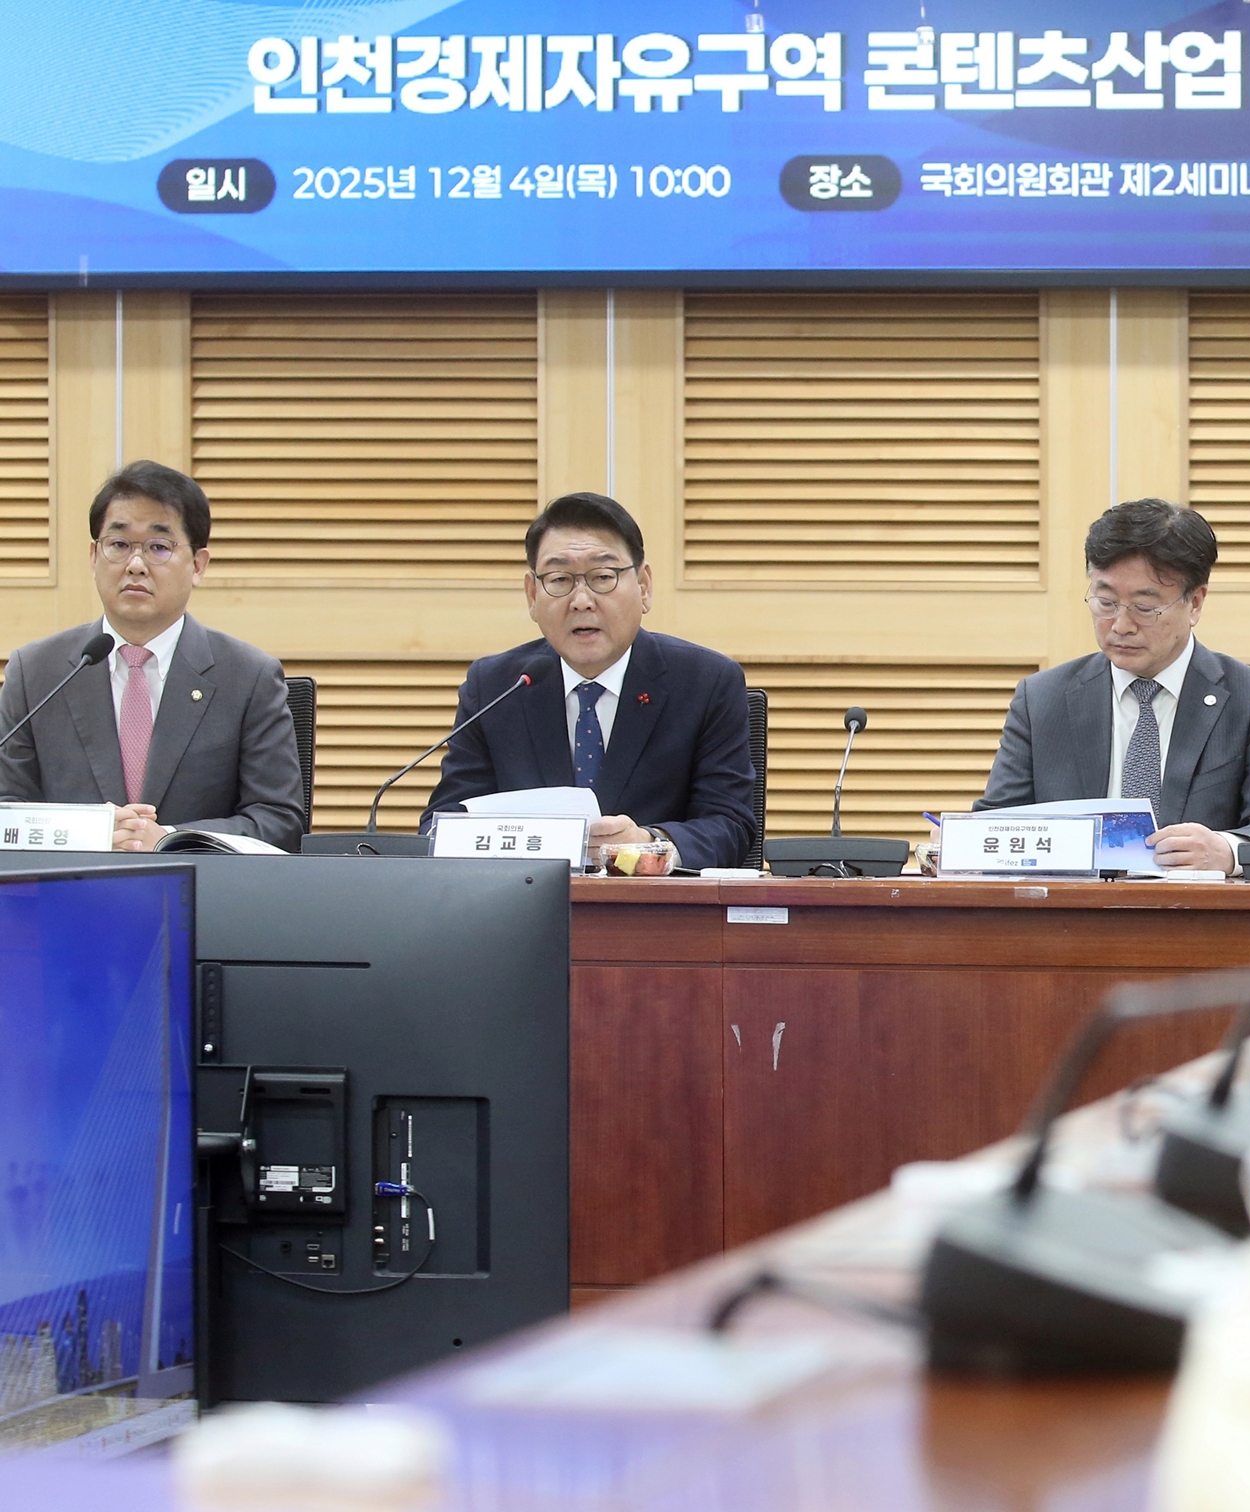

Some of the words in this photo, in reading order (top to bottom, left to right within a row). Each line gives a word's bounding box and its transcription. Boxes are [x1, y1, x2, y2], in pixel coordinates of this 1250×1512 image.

[247, 33, 842, 114] 인천경제자유구역
[864, 30, 1242, 110] 콘텐츠산업
[185, 167, 246, 201] 일시
[292, 165, 416, 199] 2025년
[428, 165, 502, 199] 12월
[509, 164, 618, 199] 4일(목)
[630, 165, 731, 198] 10:00
[809, 164, 873, 200] 장소
[920, 162, 1113, 197] 국회의원회관
[497, 824, 524, 832] 국회의원
